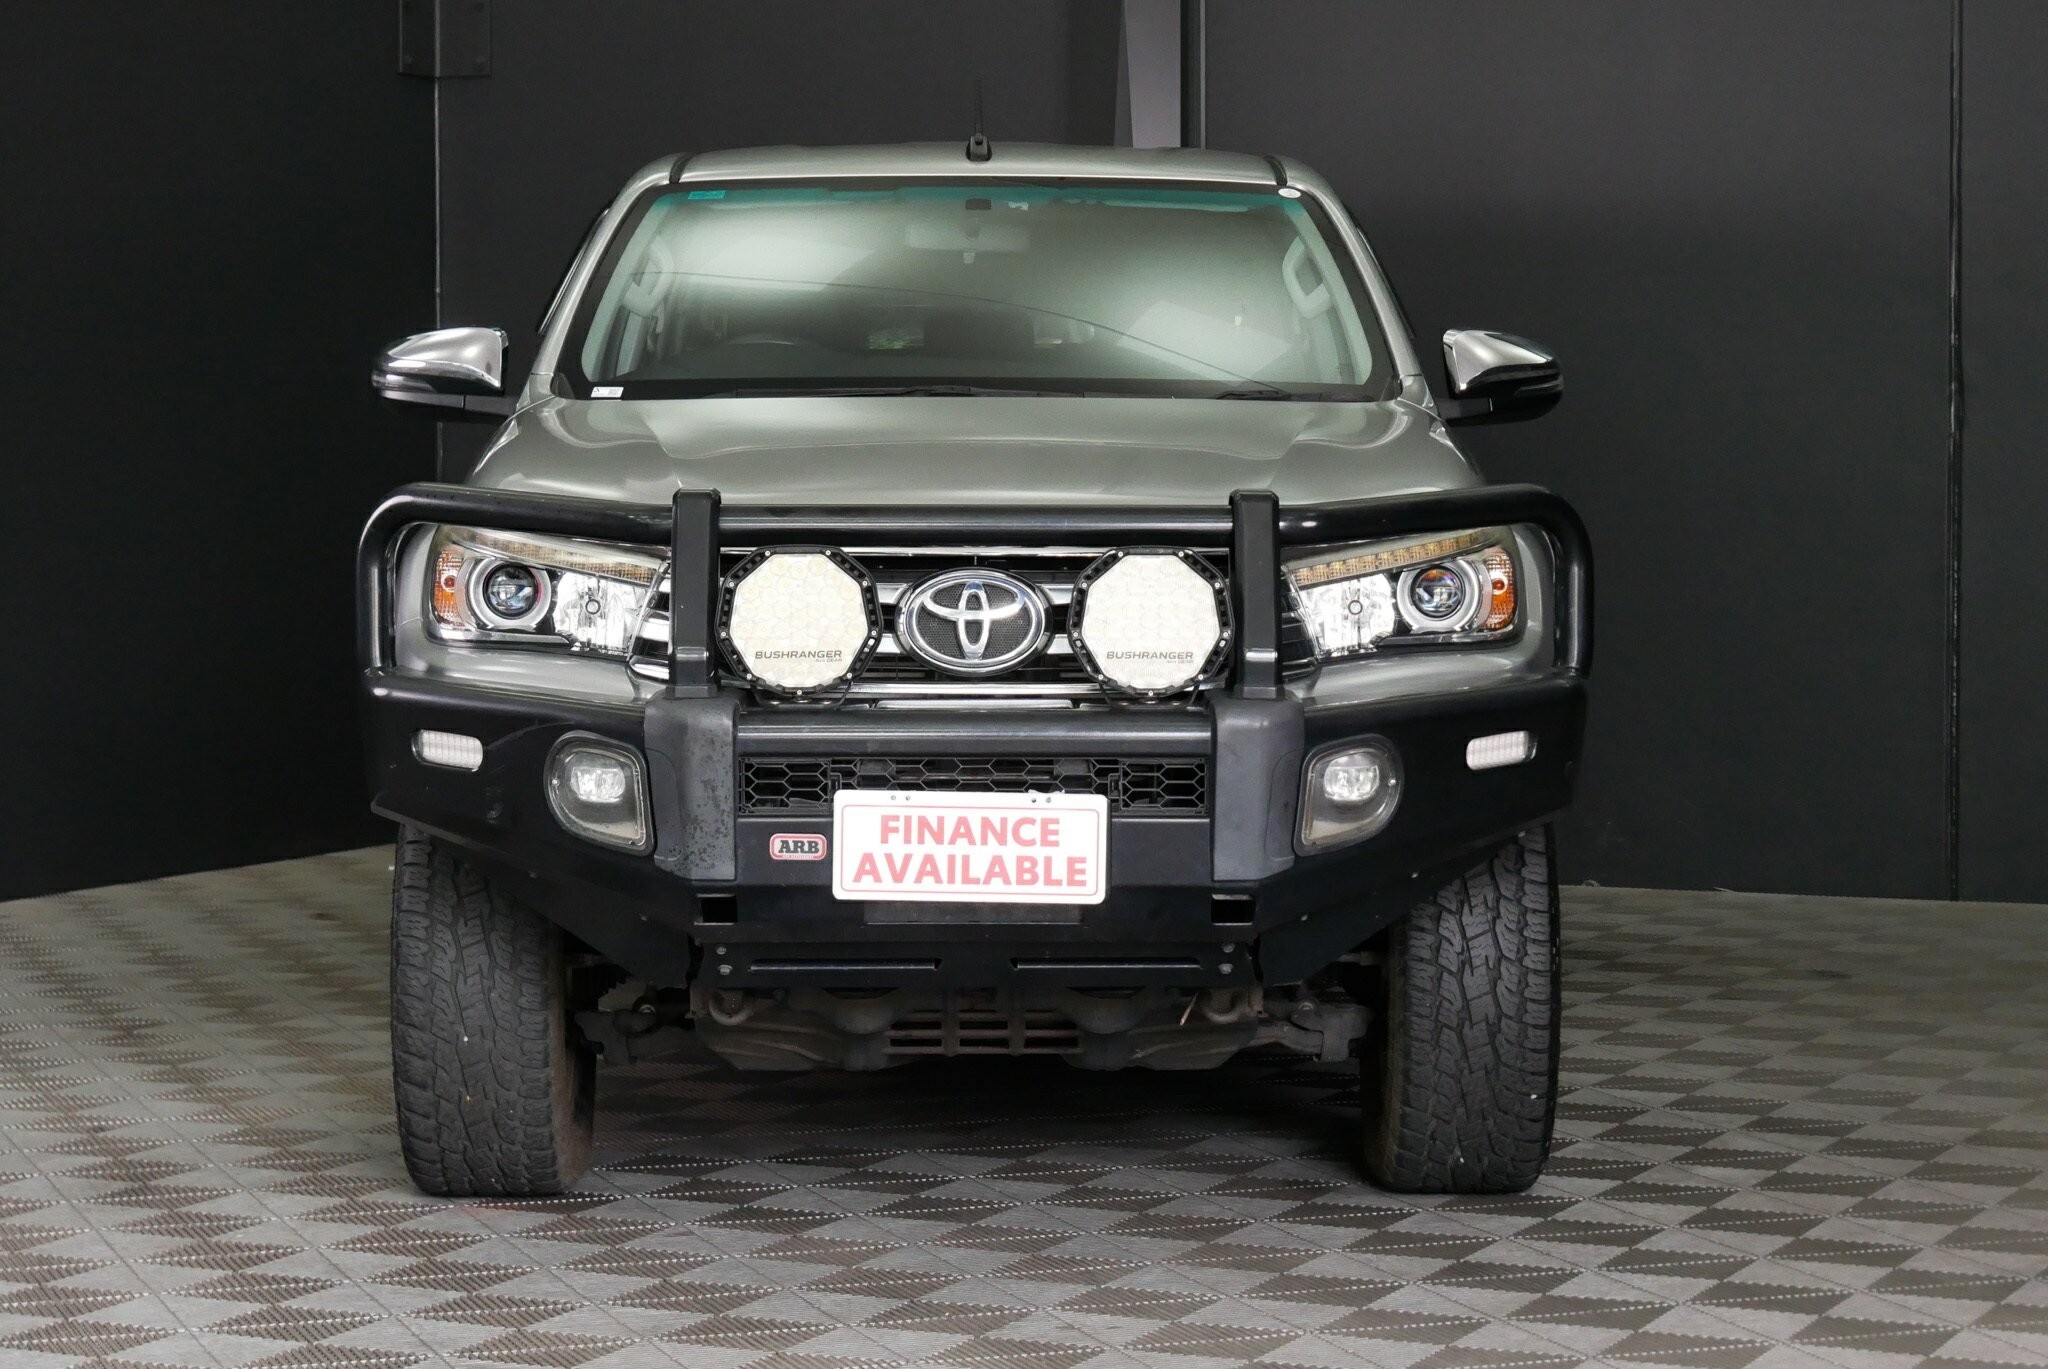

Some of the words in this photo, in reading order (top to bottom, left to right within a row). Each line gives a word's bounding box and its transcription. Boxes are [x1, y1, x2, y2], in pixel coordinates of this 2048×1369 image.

[755, 650, 843, 659] BUSHRANGER
[1106, 651, 1194, 660] BUSHRANGER
[880, 814, 1060, 847] FINANCE
[778, 840, 820, 854] ARB
[852, 852, 1087, 887] AVAILABLE
